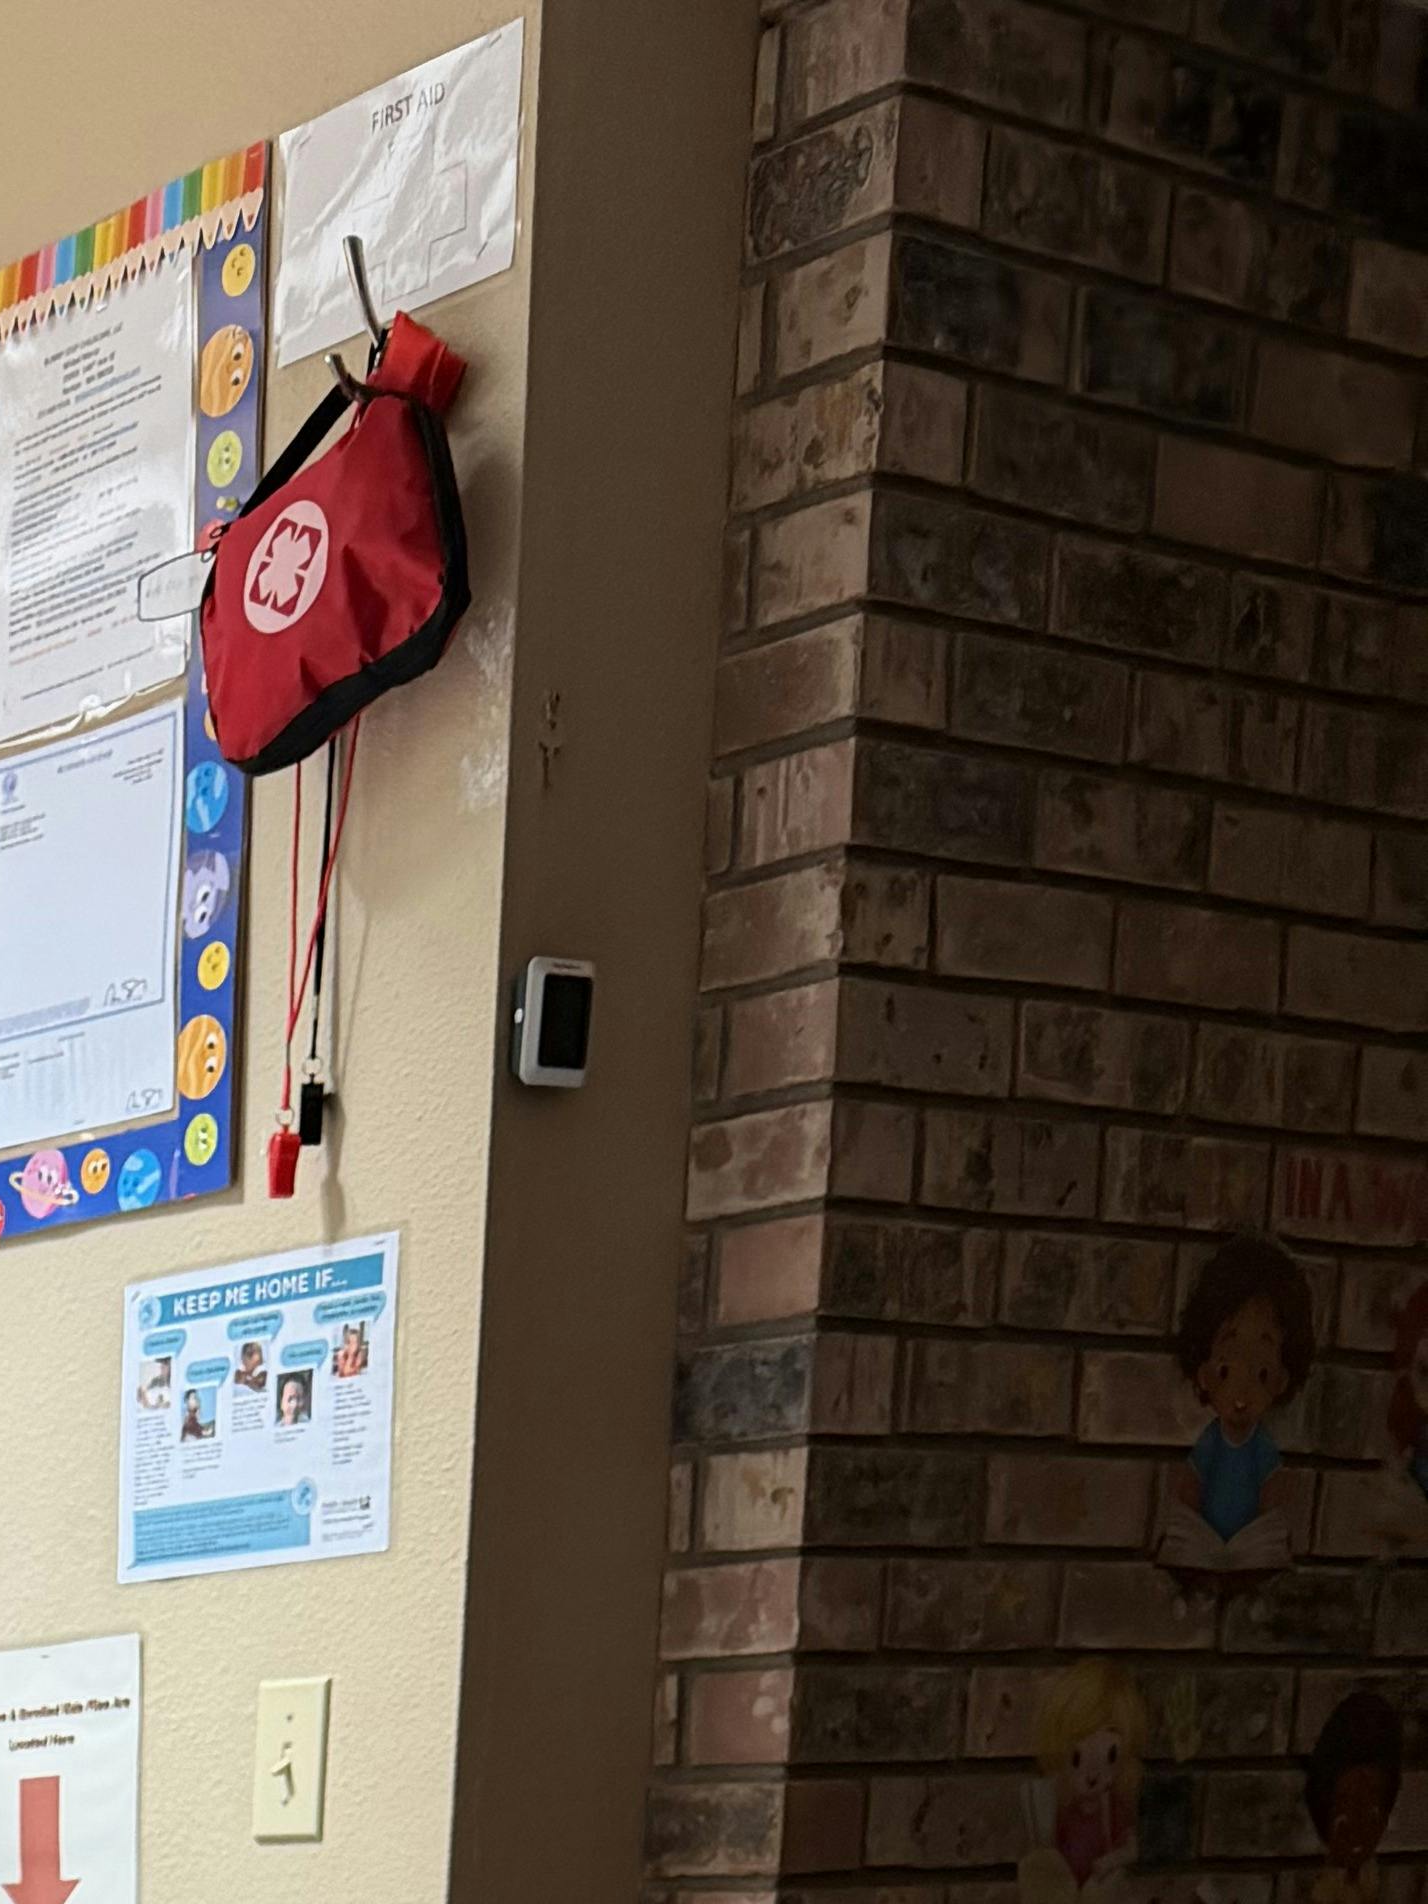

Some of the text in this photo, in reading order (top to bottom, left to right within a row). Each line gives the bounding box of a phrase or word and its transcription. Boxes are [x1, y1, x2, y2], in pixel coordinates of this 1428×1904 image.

[372, 82, 445, 134] FIRST AID
[173, 1290, 222, 1318] KEEP
[225, 1282, 250, 1308] ME
[254, 1272, 310, 1302] HOME
